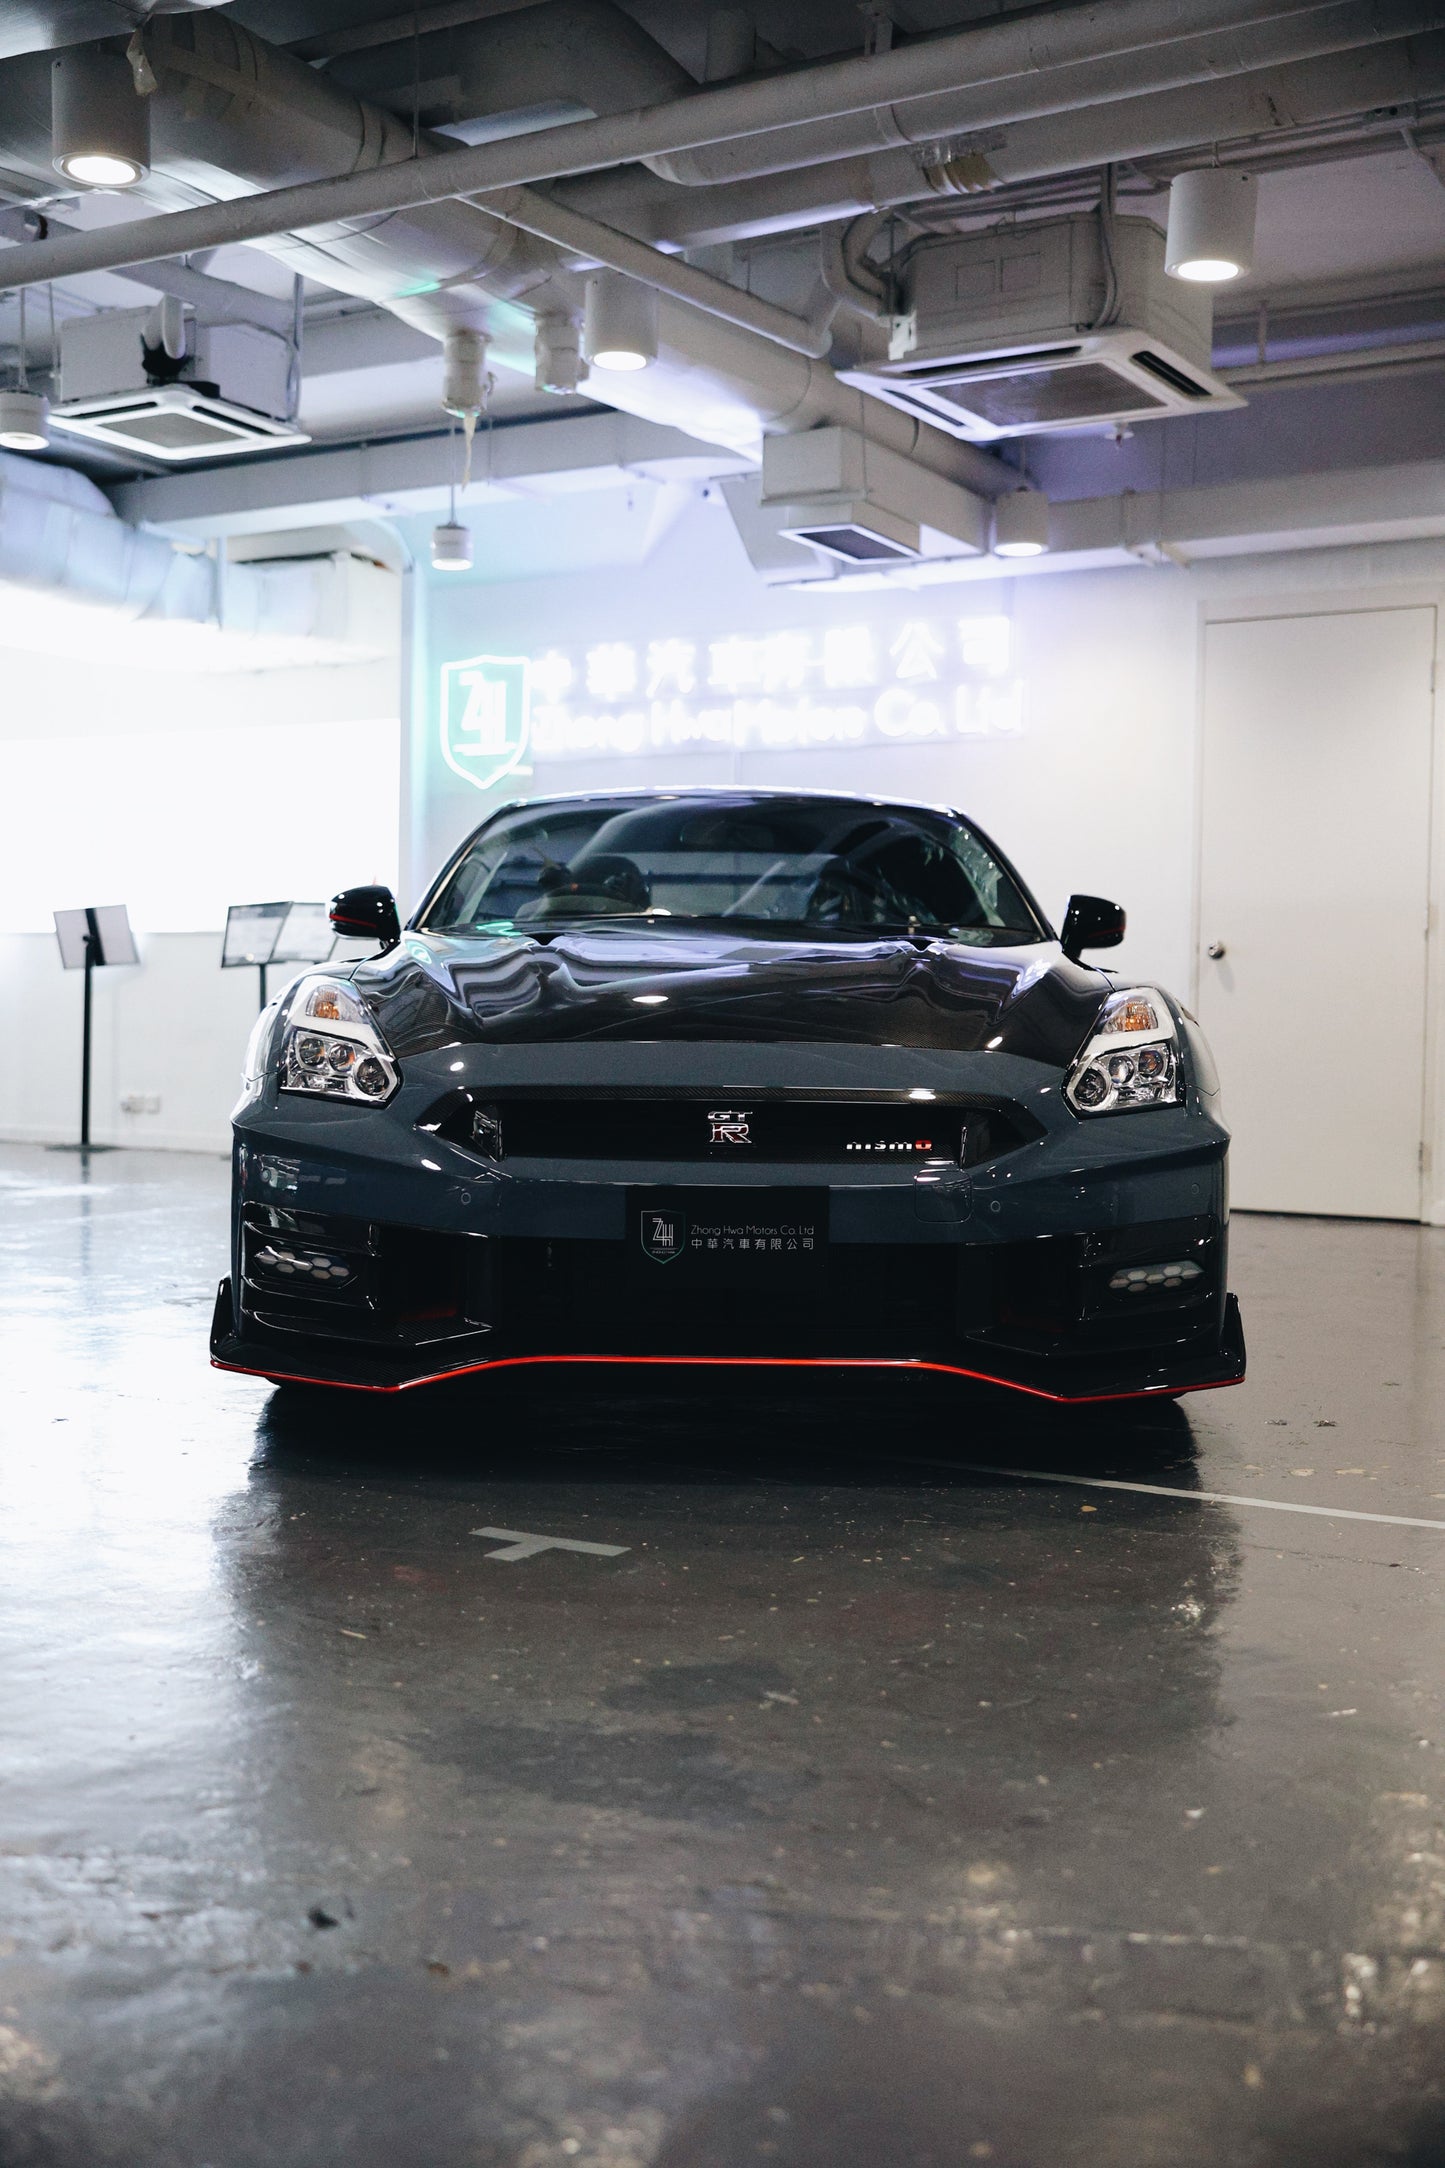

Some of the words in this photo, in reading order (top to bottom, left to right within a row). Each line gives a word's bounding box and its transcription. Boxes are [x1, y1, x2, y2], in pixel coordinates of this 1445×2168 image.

[690, 1224, 721, 1236] Zhong
[723, 1224, 744, 1235] Hwa
[746, 1224, 778, 1235] Motors
[691, 1238, 814, 1250] 中華汽車有限公司
